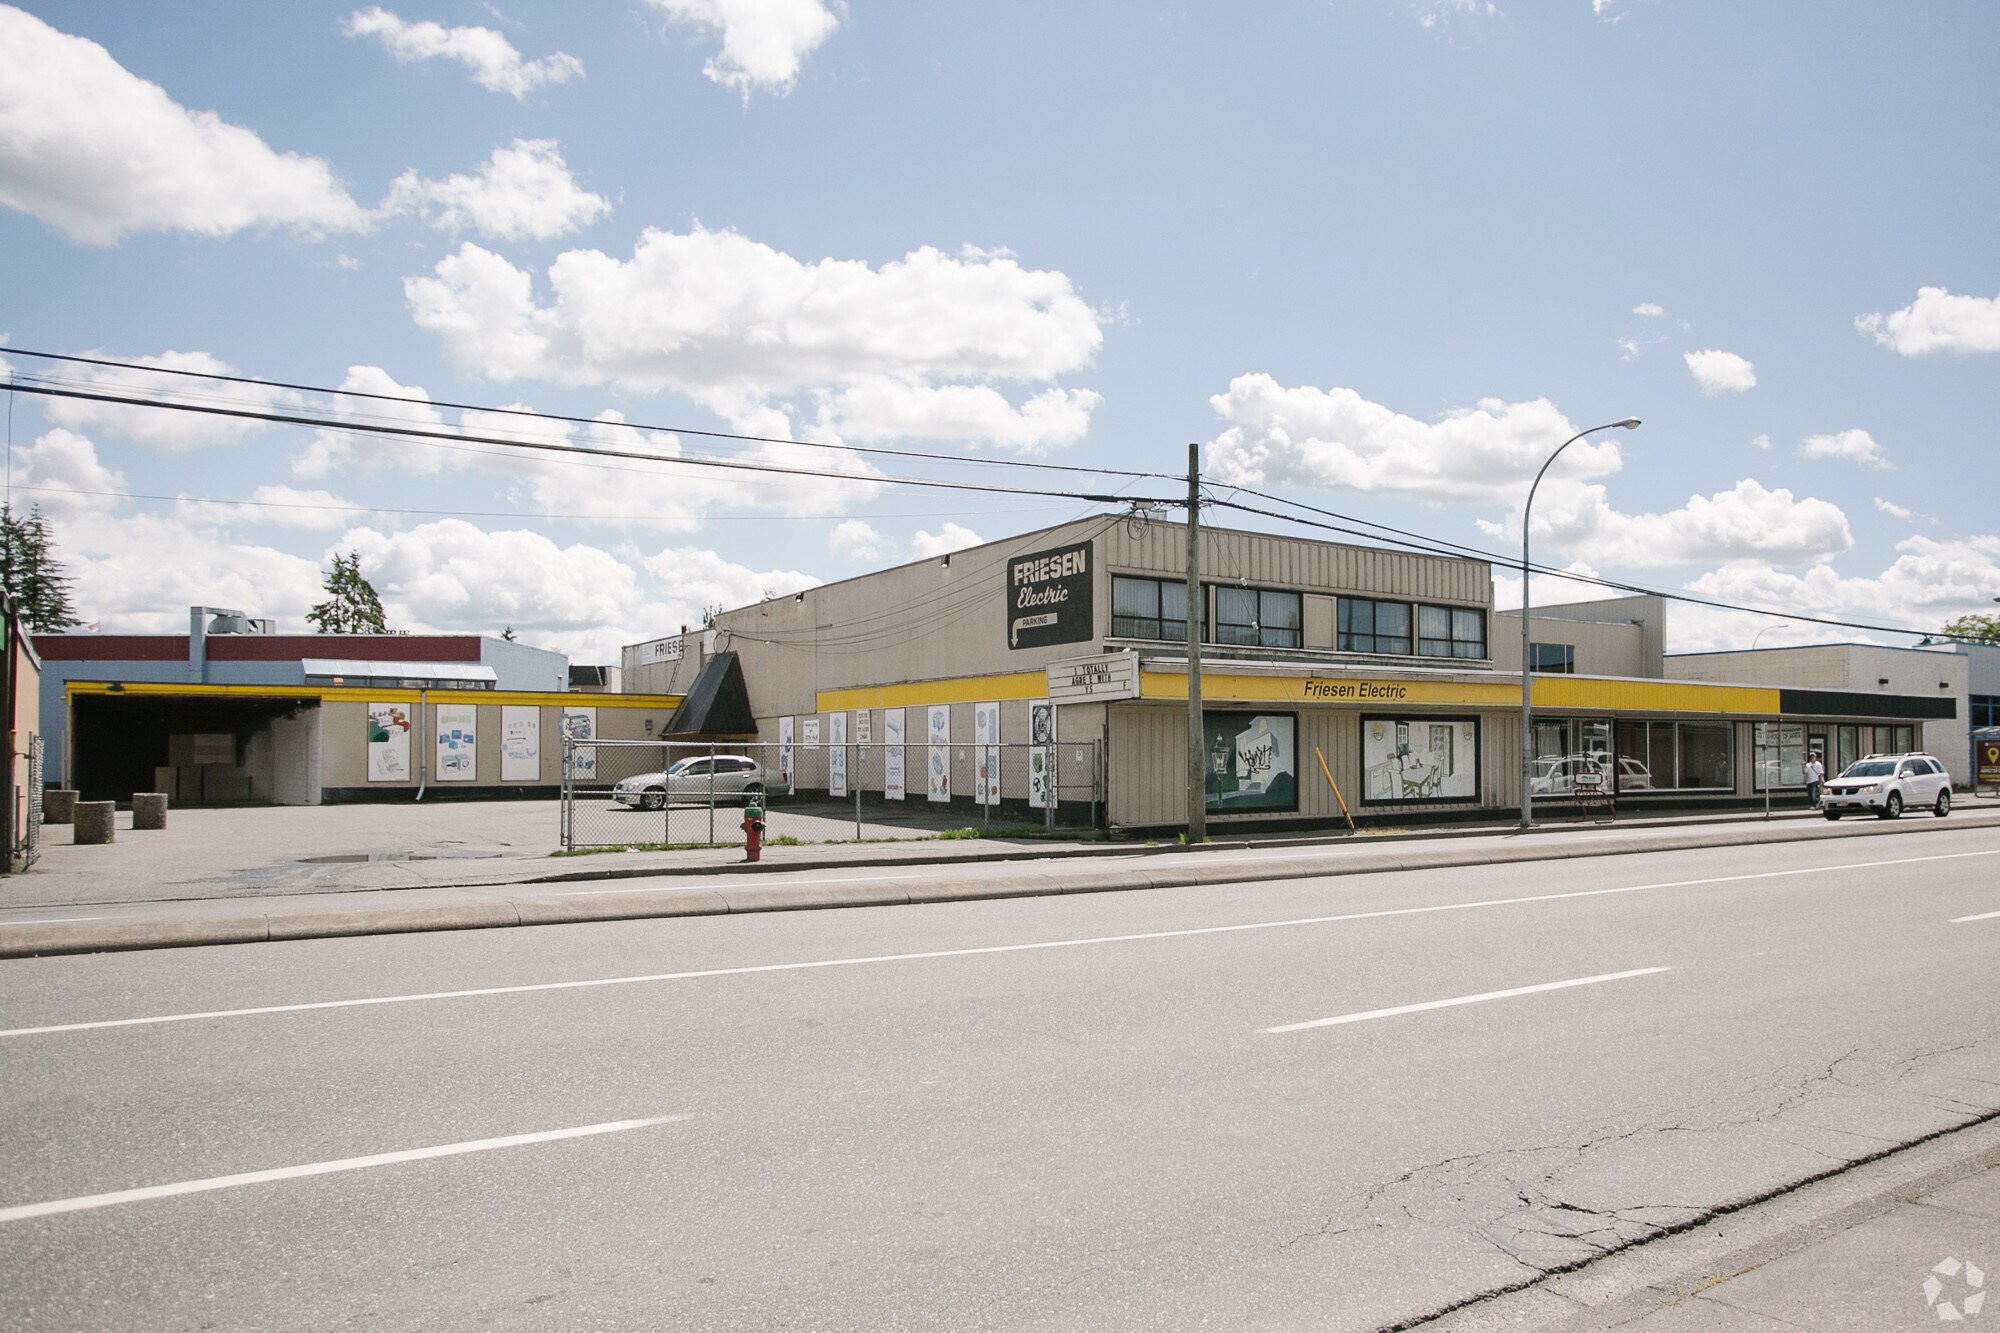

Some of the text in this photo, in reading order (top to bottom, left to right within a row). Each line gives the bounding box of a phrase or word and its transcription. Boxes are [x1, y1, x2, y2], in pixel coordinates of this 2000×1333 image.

[1014, 550, 1086, 586] FRIESEN
[1017, 585, 1069, 608] Electric
[1022, 616, 1048, 627] PARKING
[1083, 664, 1108, 675] TOTALLY
[1097, 673, 1111, 683] WITH
[1304, 681, 1407, 698] Friesen Electric
